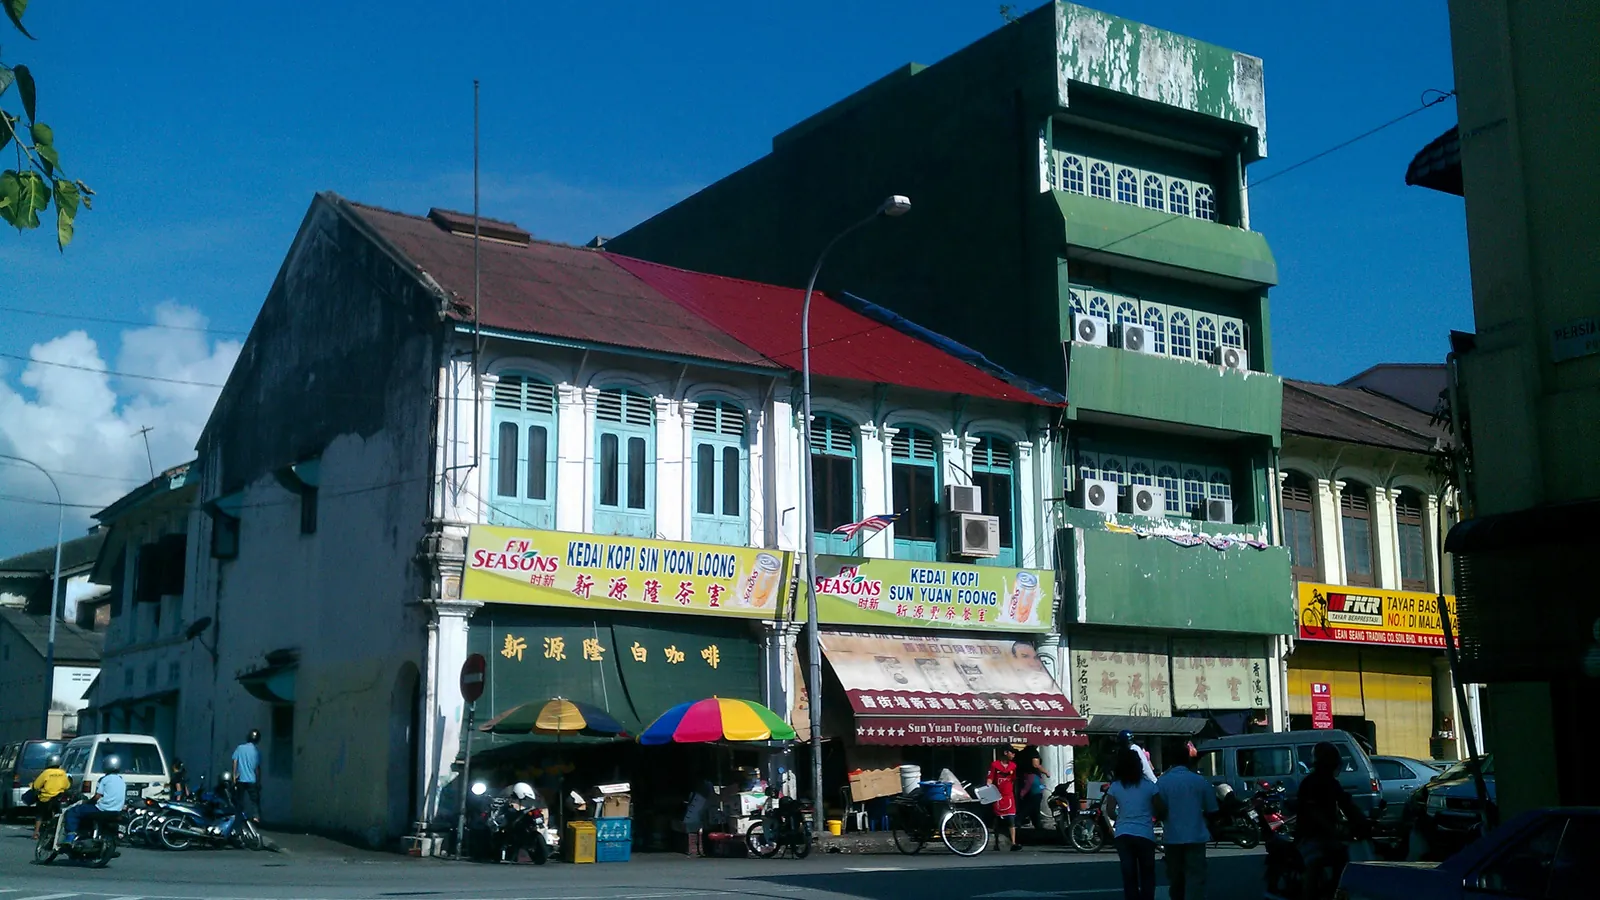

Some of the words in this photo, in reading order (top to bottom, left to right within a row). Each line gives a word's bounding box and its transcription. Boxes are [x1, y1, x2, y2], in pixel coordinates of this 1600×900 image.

[472, 549, 558, 572] SEASONS
[567, 541, 604, 568] KEDAI
[607, 544, 635, 570] KOPI
[639, 547, 659, 573] SIN
[663, 549, 695, 575] YOON
[697, 552, 736, 578] LOONG
[530, 574, 555, 588] 时新
[815, 576, 881, 596] SEASONS
[911, 568, 946, 585] KEDAI
[952, 571, 978, 587] KOPI
[572, 573, 725, 608] 新源隆茶室
[889, 585, 914, 601] SUN
[920, 587, 952, 603] YUAN
[958, 589, 997, 606] FOONG
[858, 598, 879, 610] 时新
[1343, 594, 1381, 614] FKR
[1387, 596, 1415, 612] TAYAR
[1388, 612, 1406, 627] NO.1
[1409, 614, 1416, 628] DI
[1334, 629, 1348, 639] LEAN
[1348, 630, 1365, 641] SEANG
[1366, 631, 1386, 642] TRADING
[500, 633, 721, 669] 新源隆白咖啡
[908, 723, 926, 732] Sun
[928, 723, 952, 733] Yuan
[954, 723, 983, 735] Foong
[984, 723, 1011, 733] White
[1012, 723, 1042, 733] Coffee
[921, 735, 935, 743] The
[936, 735, 952, 743] Best
[953, 735, 975, 743] White
[976, 735, 999, 743] Coffee
[1008, 735, 1027, 743] Town
